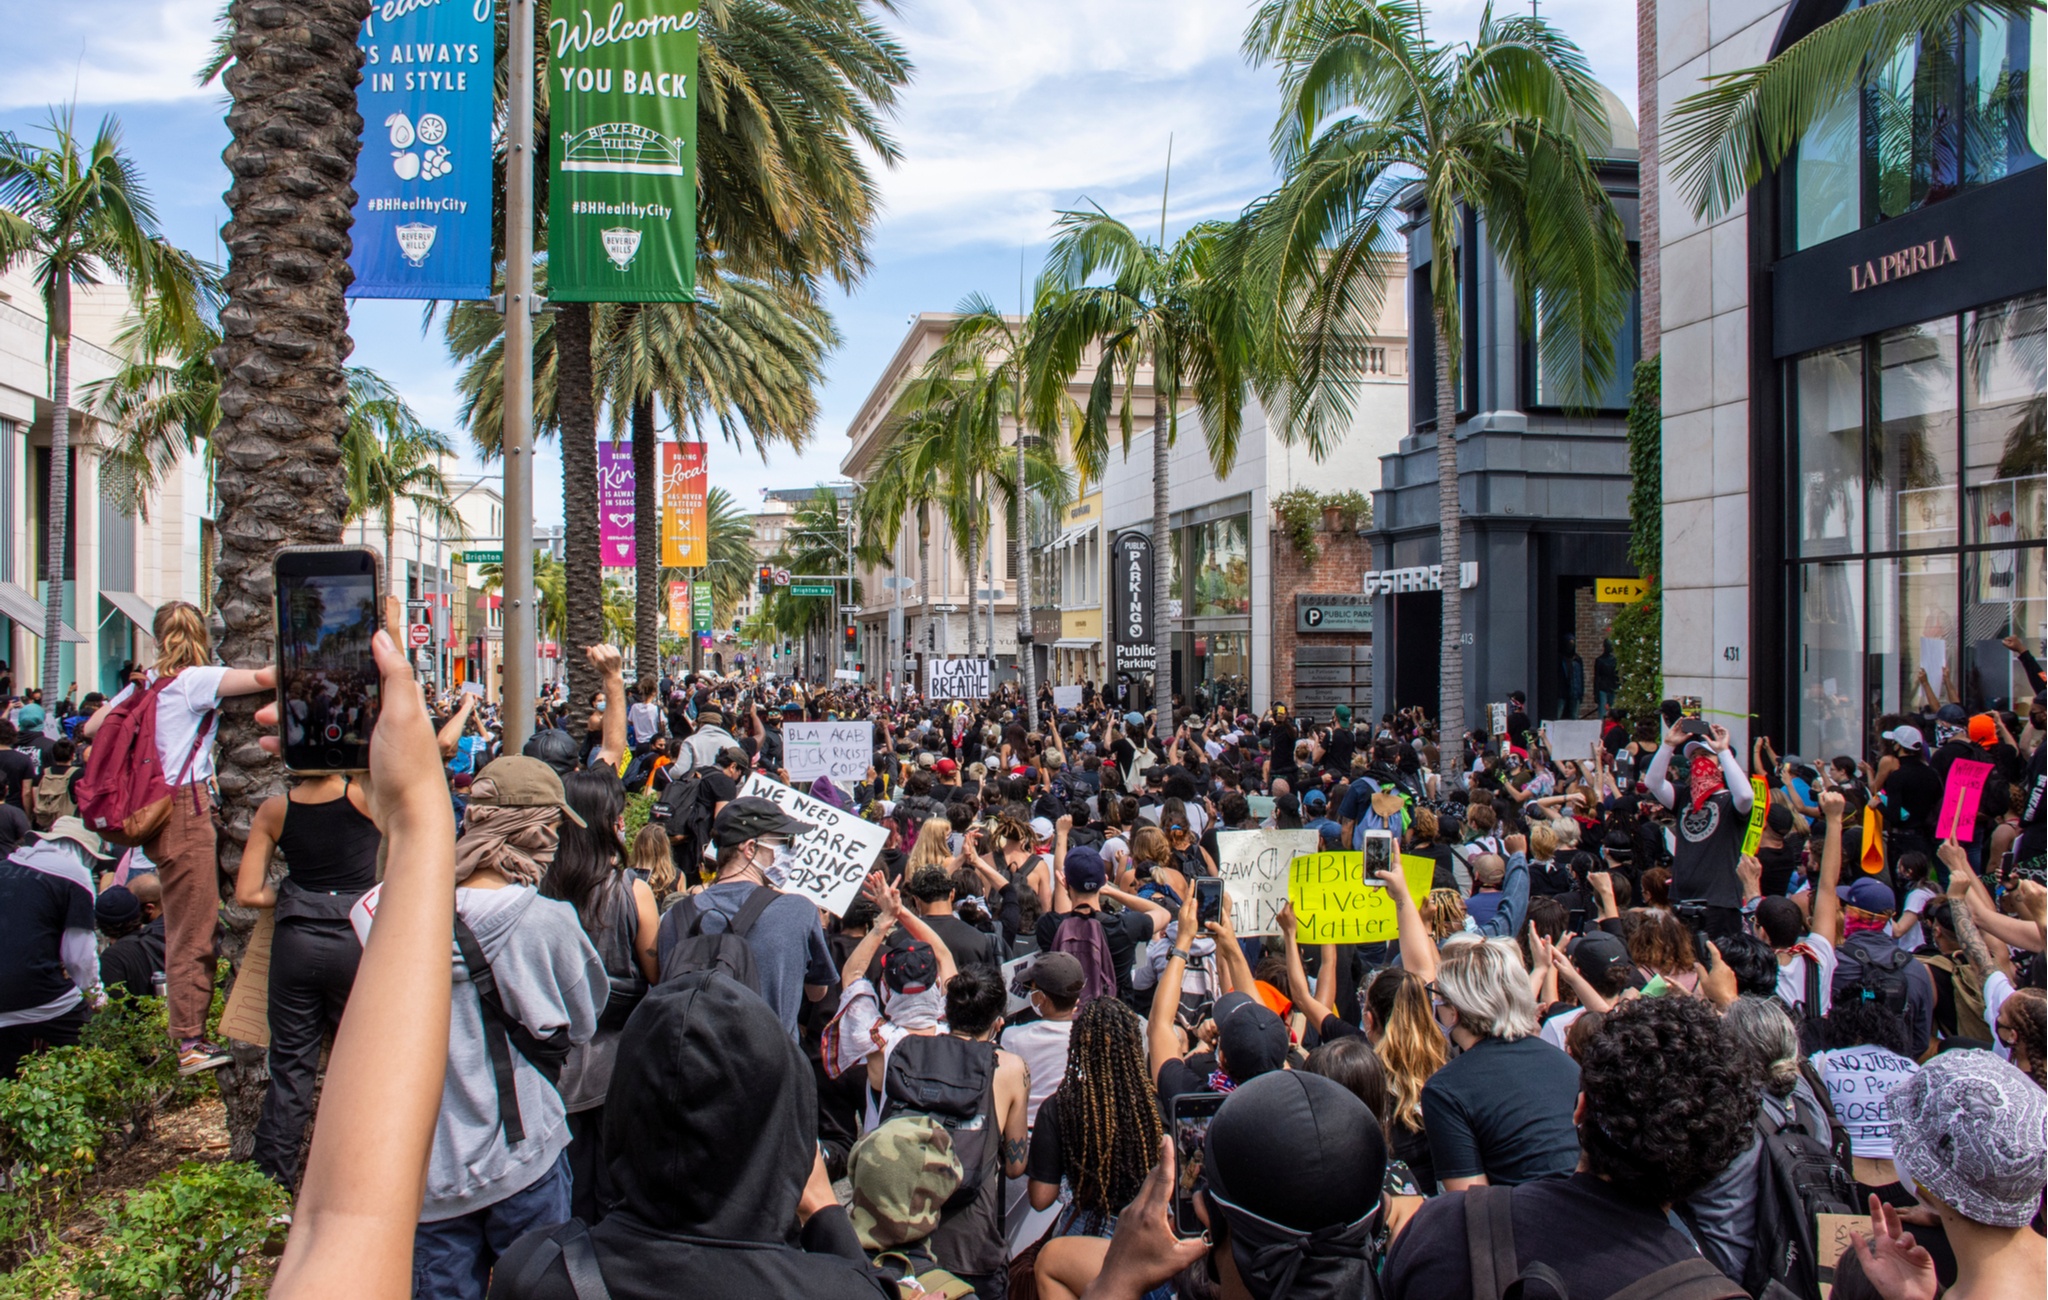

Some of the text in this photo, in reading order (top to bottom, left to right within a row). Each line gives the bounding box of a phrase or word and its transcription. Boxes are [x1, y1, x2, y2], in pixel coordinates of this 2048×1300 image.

[550, 2, 699, 59] Welcome
[361, 44, 480, 65] S ALWAYS
[372, 72, 467, 92] IN STYLE
[560, 67, 688, 99] YOU BACK
[588, 123, 660, 142] BEVERLY
[602, 139, 643, 150] HILLS
[368, 197, 468, 214] #BHHealthyCity
[572, 201, 672, 220] #BHHealthyCity
[402, 232, 432, 241] BEVERLY
[606, 236, 637, 245] BEVERLY
[406, 241, 427, 250] HILLS
[611, 245, 632, 254] HILLS
[1849, 235, 1958, 293] LA PERLA
[598, 462, 636, 489] Kin
[661, 453, 708, 494] Local
[613, 490, 636, 498] ALWAY
[667, 500, 702, 508] MATTERED
[1124, 541, 1147, 550] PUBLIC
[465, 553, 501, 562] Brighton
[792, 587, 833, 595] Brighton Way
[1129, 550, 1142, 623] PARKING
[1604, 585, 1629, 595] CAFÉ
[1323, 610, 1352, 618] PUBLIC
[1353, 610, 1373, 618] PARK
[1116, 644, 1157, 657] Public
[1723, 646, 1740, 661] 431
[1117, 658, 1157, 671] Parking
[931, 675, 988, 698] BREATHE
[788, 727, 866, 742] BLM ACAB
[788, 746, 869, 768] FUCK RACIST
[752, 778, 840, 826] WE NEED
[801, 823, 867, 860] CARE
[789, 867, 841, 899] OPS!
[1300, 886, 1383, 912] Lives
[1827, 1054, 1861, 1072] NO
[1826, 1078, 1855, 1094] NO
